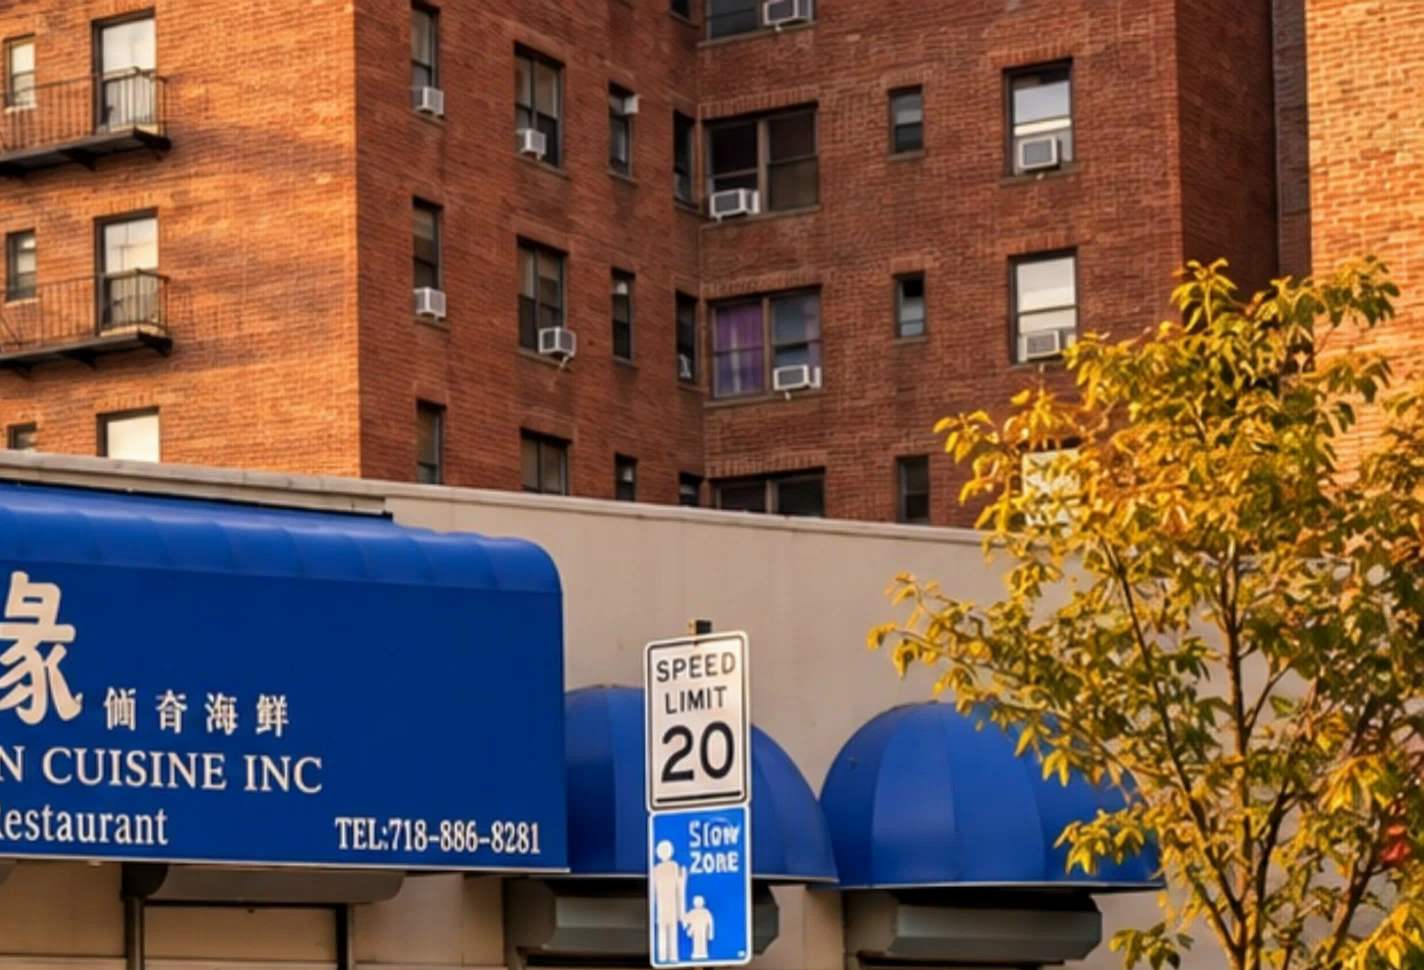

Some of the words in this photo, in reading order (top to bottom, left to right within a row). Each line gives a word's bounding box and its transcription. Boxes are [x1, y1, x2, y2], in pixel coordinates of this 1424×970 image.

[656, 651, 736, 683] SPEED
[665, 686, 728, 715] LIMIT
[43, 747, 227, 790] CUISINE
[243, 756, 323, 794] INC
[661, 721, 734, 783] 20
